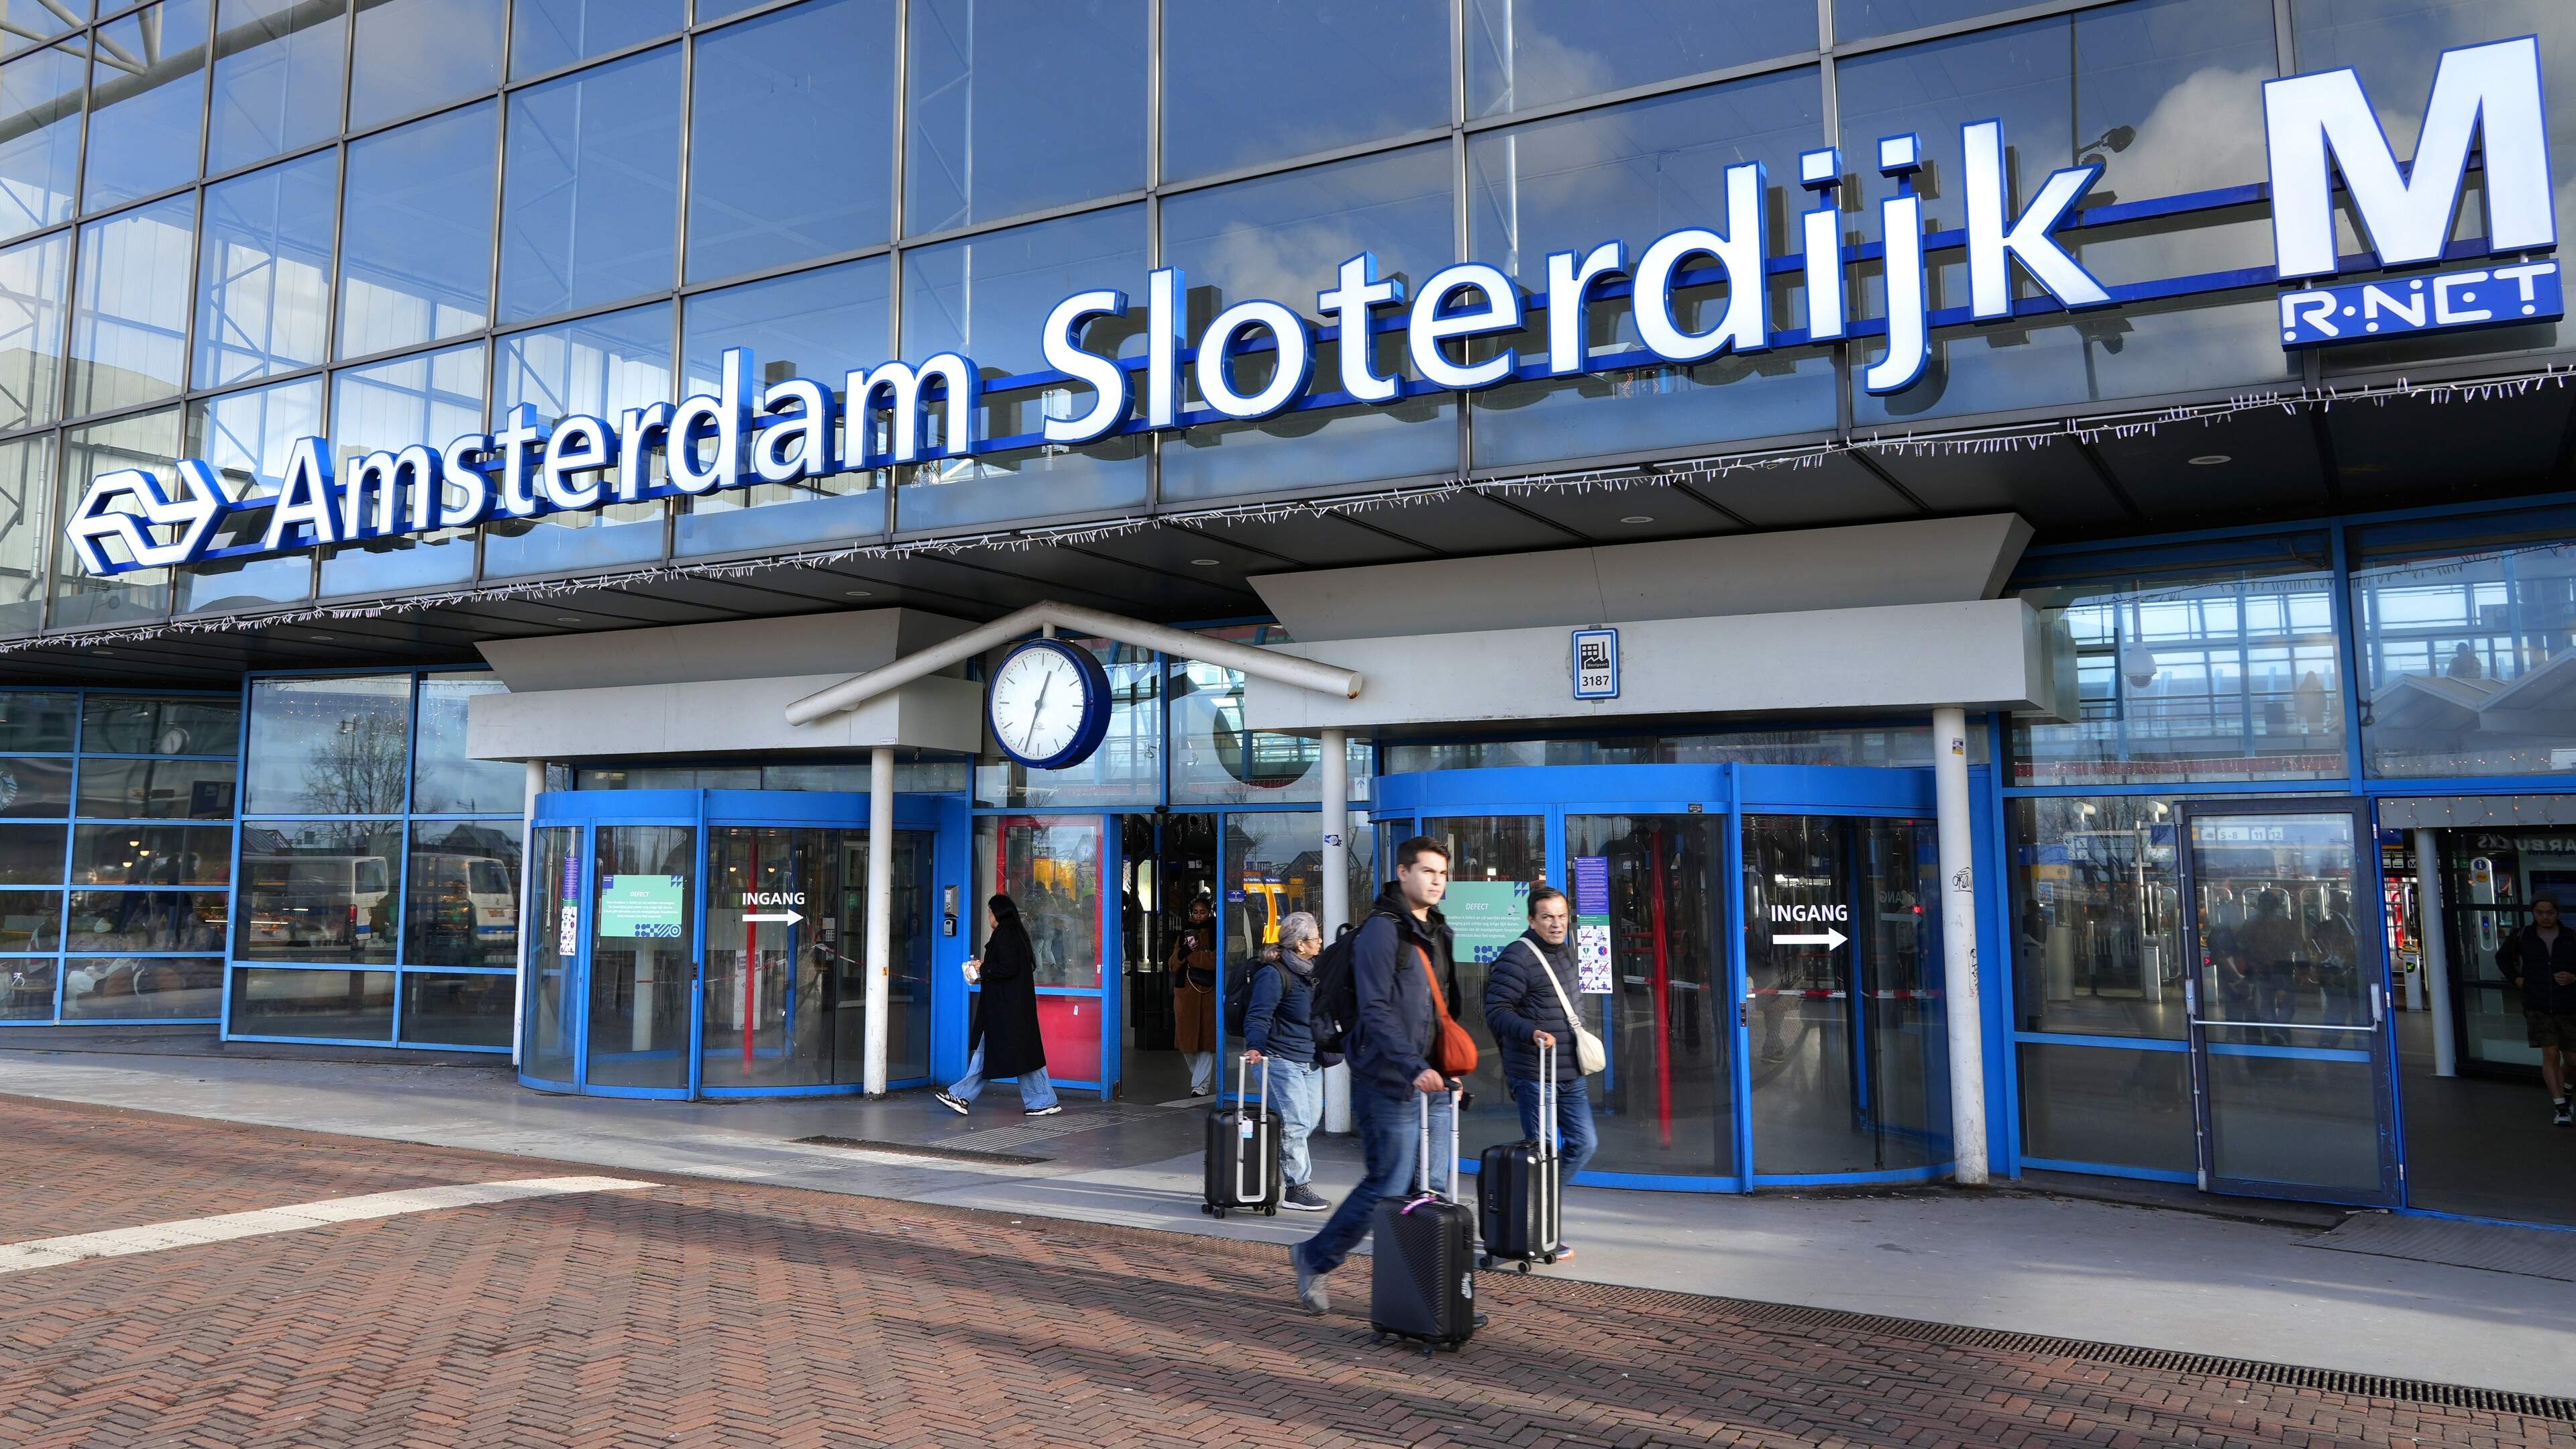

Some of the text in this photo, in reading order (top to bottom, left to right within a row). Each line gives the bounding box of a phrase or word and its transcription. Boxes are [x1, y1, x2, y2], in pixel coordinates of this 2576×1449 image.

[2263, 35, 2557, 280] M
[266, 117, 2112, 551] Amsterdam Sloterdijk
[1582, 676, 1609, 686] 3187
[742, 892, 804, 905] INGANG
[1771, 904, 1847, 922] INGANG
